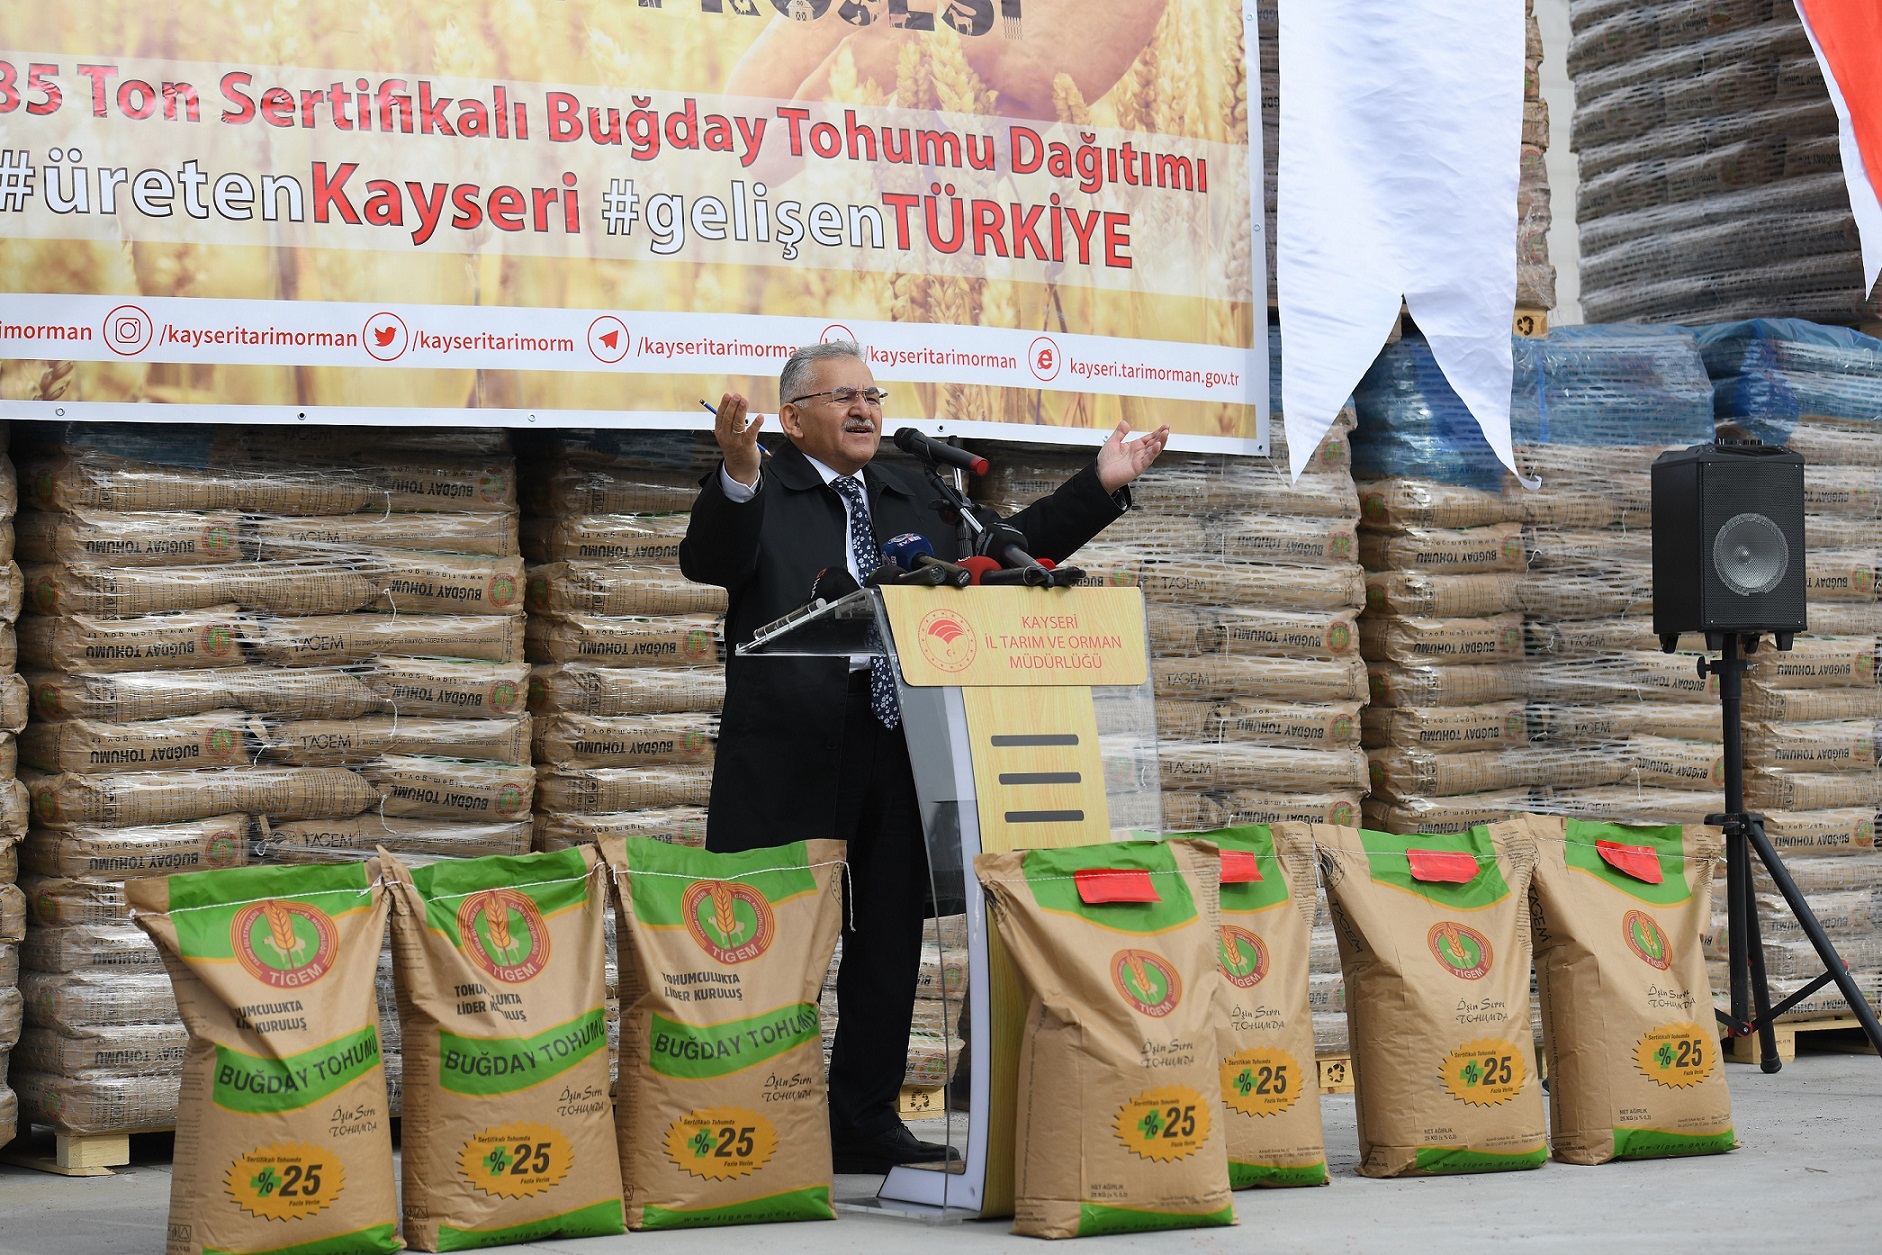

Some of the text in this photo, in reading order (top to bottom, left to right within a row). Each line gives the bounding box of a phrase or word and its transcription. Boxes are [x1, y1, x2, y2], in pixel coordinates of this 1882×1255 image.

[77, 63, 201, 122] Ton
[219, 71, 529, 141] Sertifikalı
[545, 91, 768, 167] Buğday
[777, 106, 996, 172] Tohumu
[1010, 126, 1208, 194] Dağıtımı
[602, 178, 1133, 270] #gelişenTÜRKİYE
[159, 324, 358, 348] /kayseritarimorman
[412, 330, 574, 354] /kayseritarimorm
[637, 335, 799, 360] /kayseritarimorma
[864, 345, 1018, 370] /kayseritarimorman
[1070, 357, 1240, 389] kayseri.tarimorman.gov.tr
[290, 531, 341, 544] TAGEM
[1416, 551, 1497, 564] BUĞDAY TOHUMU
[1161, 577, 1206, 590] TAGEM
[1814, 576, 1848, 590] BUĞDAY
[436, 584, 482, 603] BUĞDAY
[1021, 613, 1079, 629] KAYSERİ
[295, 635, 344, 651] TAGEM
[578, 640, 677, 657] BUĞDAY TOHUMU
[985, 633, 1122, 649] İL TARIM VE ORMAN
[1282, 633, 1321, 649] BUĞDAY
[1413, 640, 1495, 655] BUĞDAY TOHUMU
[86, 641, 195, 659] BUĞDAY TOHUMU
[1009, 652, 1103, 669] MÜDÜRLÜĞÜ
[1777, 663, 1851, 677] BUĞDAY TOHUMU
[1166, 672, 1210, 686] TAGEM
[1672, 677, 1706, 692] BUĞDAY
[437, 688, 482, 707] BUĞDAY
[1284, 725, 1324, 742] BUĞDAY
[1419, 726, 1500, 742] BUĞDAY TOHUMU
[300, 734, 351, 750] TAGEM
[575, 740, 674, 756] BUĞDAY TOHUMU
[90, 744, 199, 764] BUĞDAY TOHUMU
[1775, 748, 1850, 761] BUĞDAY TOHUMU
[1676, 765, 1709, 780] BUĞDAY
[443, 792, 488, 811] BUĞDAY
[302, 832, 353, 848] TAGEM
[1775, 836, 1814, 847] TOHUMU
[89, 852, 199, 870] BUĞDAY TOHUMU
[1529, 882, 1553, 944] TAGEM
[1332, 899, 1363, 954] TAGEM
[712, 943, 758, 963] TİGEM
[269, 963, 323, 987] TİGEM
[492, 962, 537, 981] TİGEM
[661, 971, 741, 985] TOHUMCULUKTA
[1229, 972, 1261, 987] TİGEM
[1453, 967, 1485, 979] TİGEM
[664, 987, 743, 1002] LİDER KURULUŞ
[1648, 983, 1668, 998] İşin
[456, 1001, 487, 1016] LİDER
[1139, 1001, 1173, 1018] TİGEM
[1232, 1004, 1253, 1017] İşin
[1456, 997, 1478, 1013] İşin
[255, 1017, 307, 1034] KURULUŞ
[654, 1011, 818, 1060] BUĞDAY TOHUMU
[444, 1016, 606, 1076] BUĞDAY TOHUMU
[1142, 1039, 1166, 1053] İşin
[218, 1036, 378, 1095] BUĞDAY TOHUMU
[764, 1073, 788, 1089] İşin
[558, 1085, 581, 1104] İşin
[331, 1105, 353, 1124] İşin
